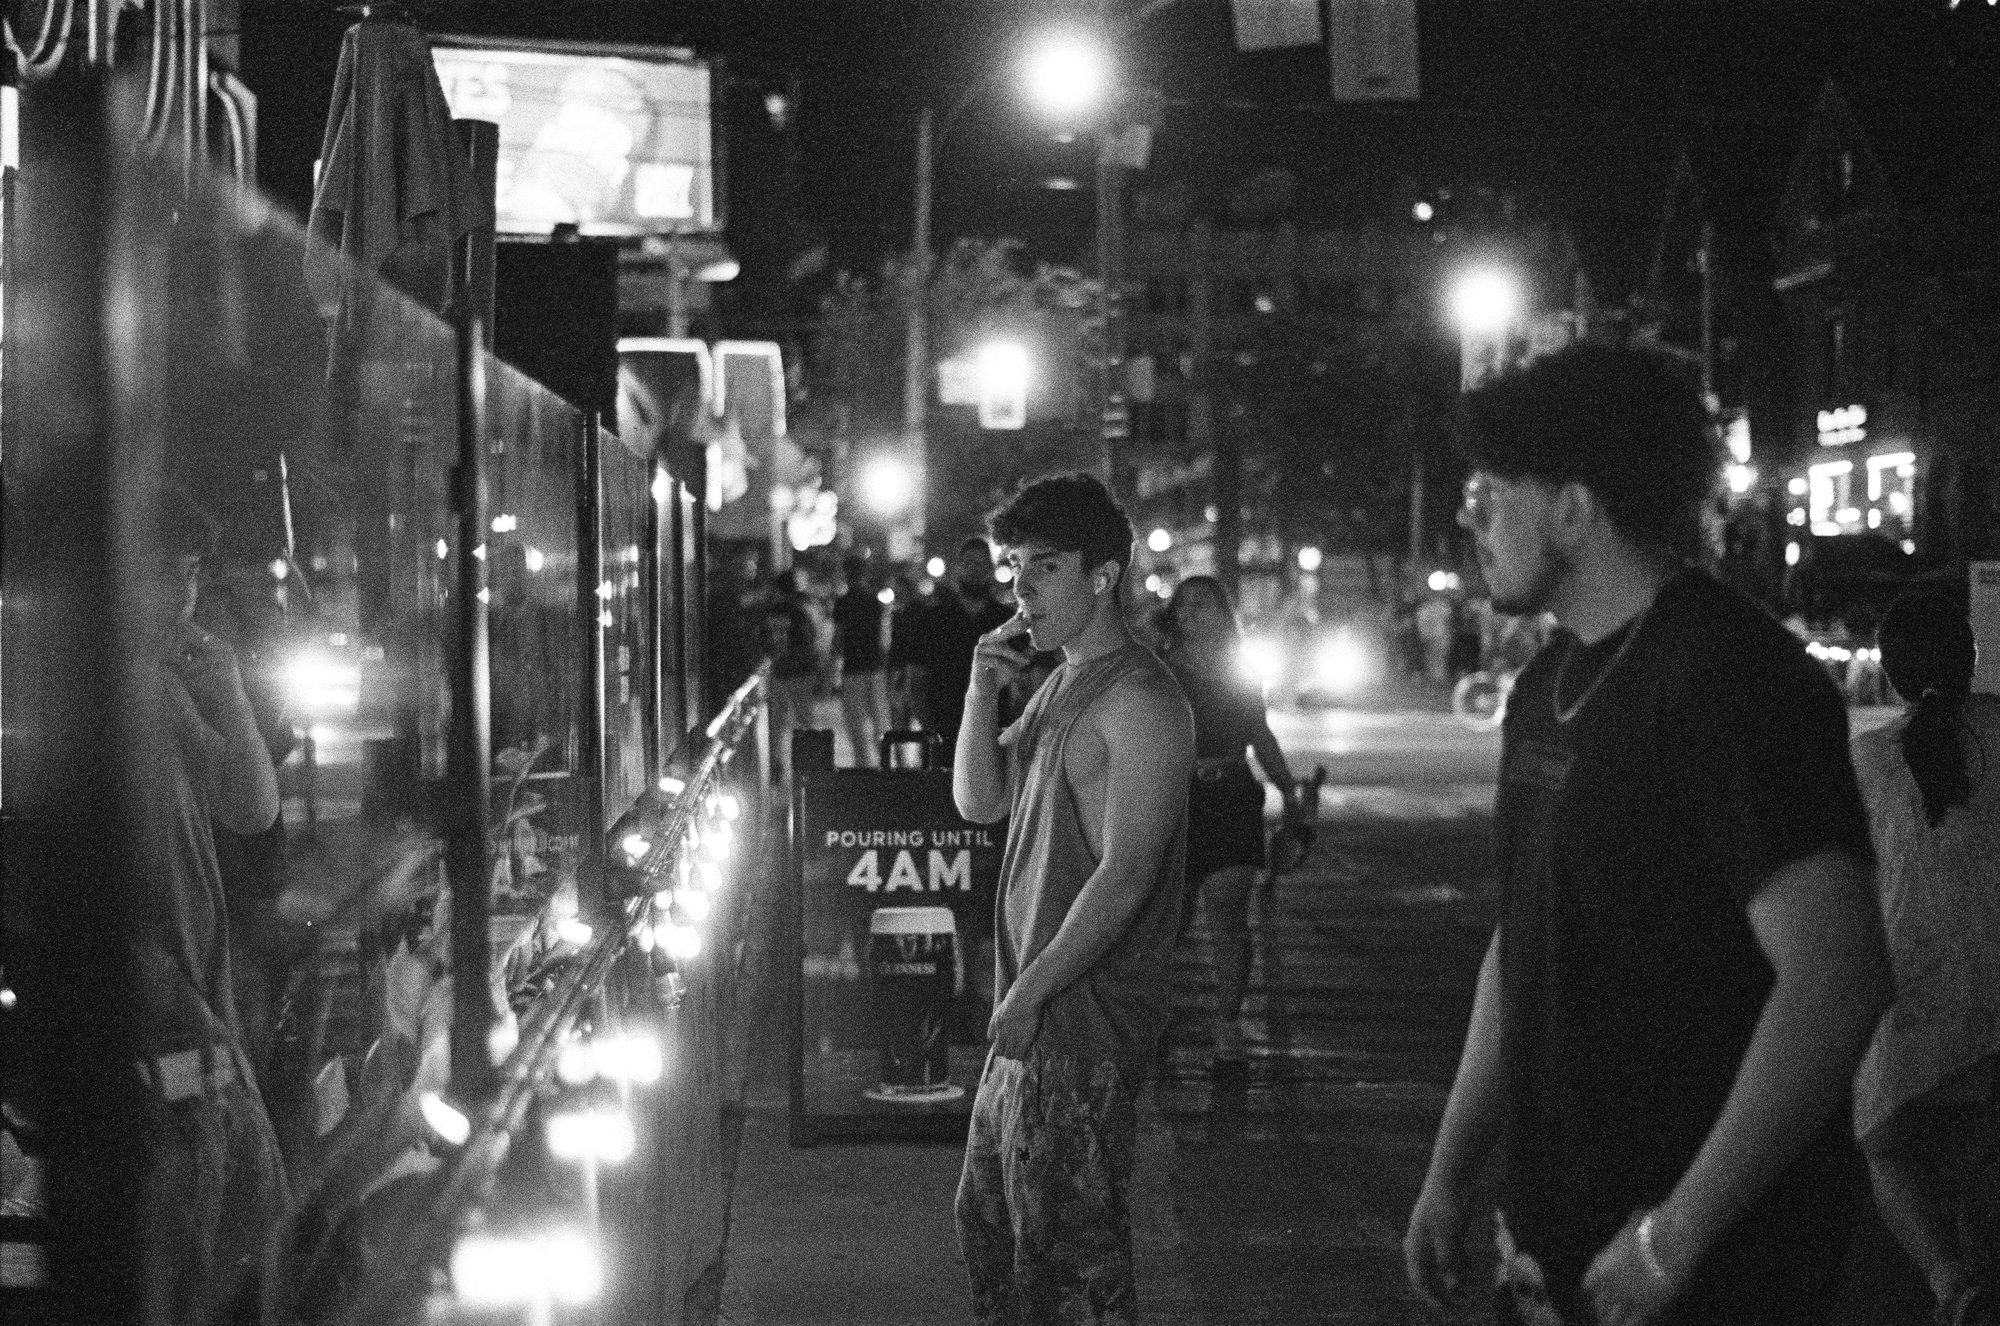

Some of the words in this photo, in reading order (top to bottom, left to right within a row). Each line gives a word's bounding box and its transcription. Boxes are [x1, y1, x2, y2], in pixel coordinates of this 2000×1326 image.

[826, 830, 924, 848] POURING
[931, 830, 994, 847] UNTIL
[847, 849, 972, 892] 4AM
